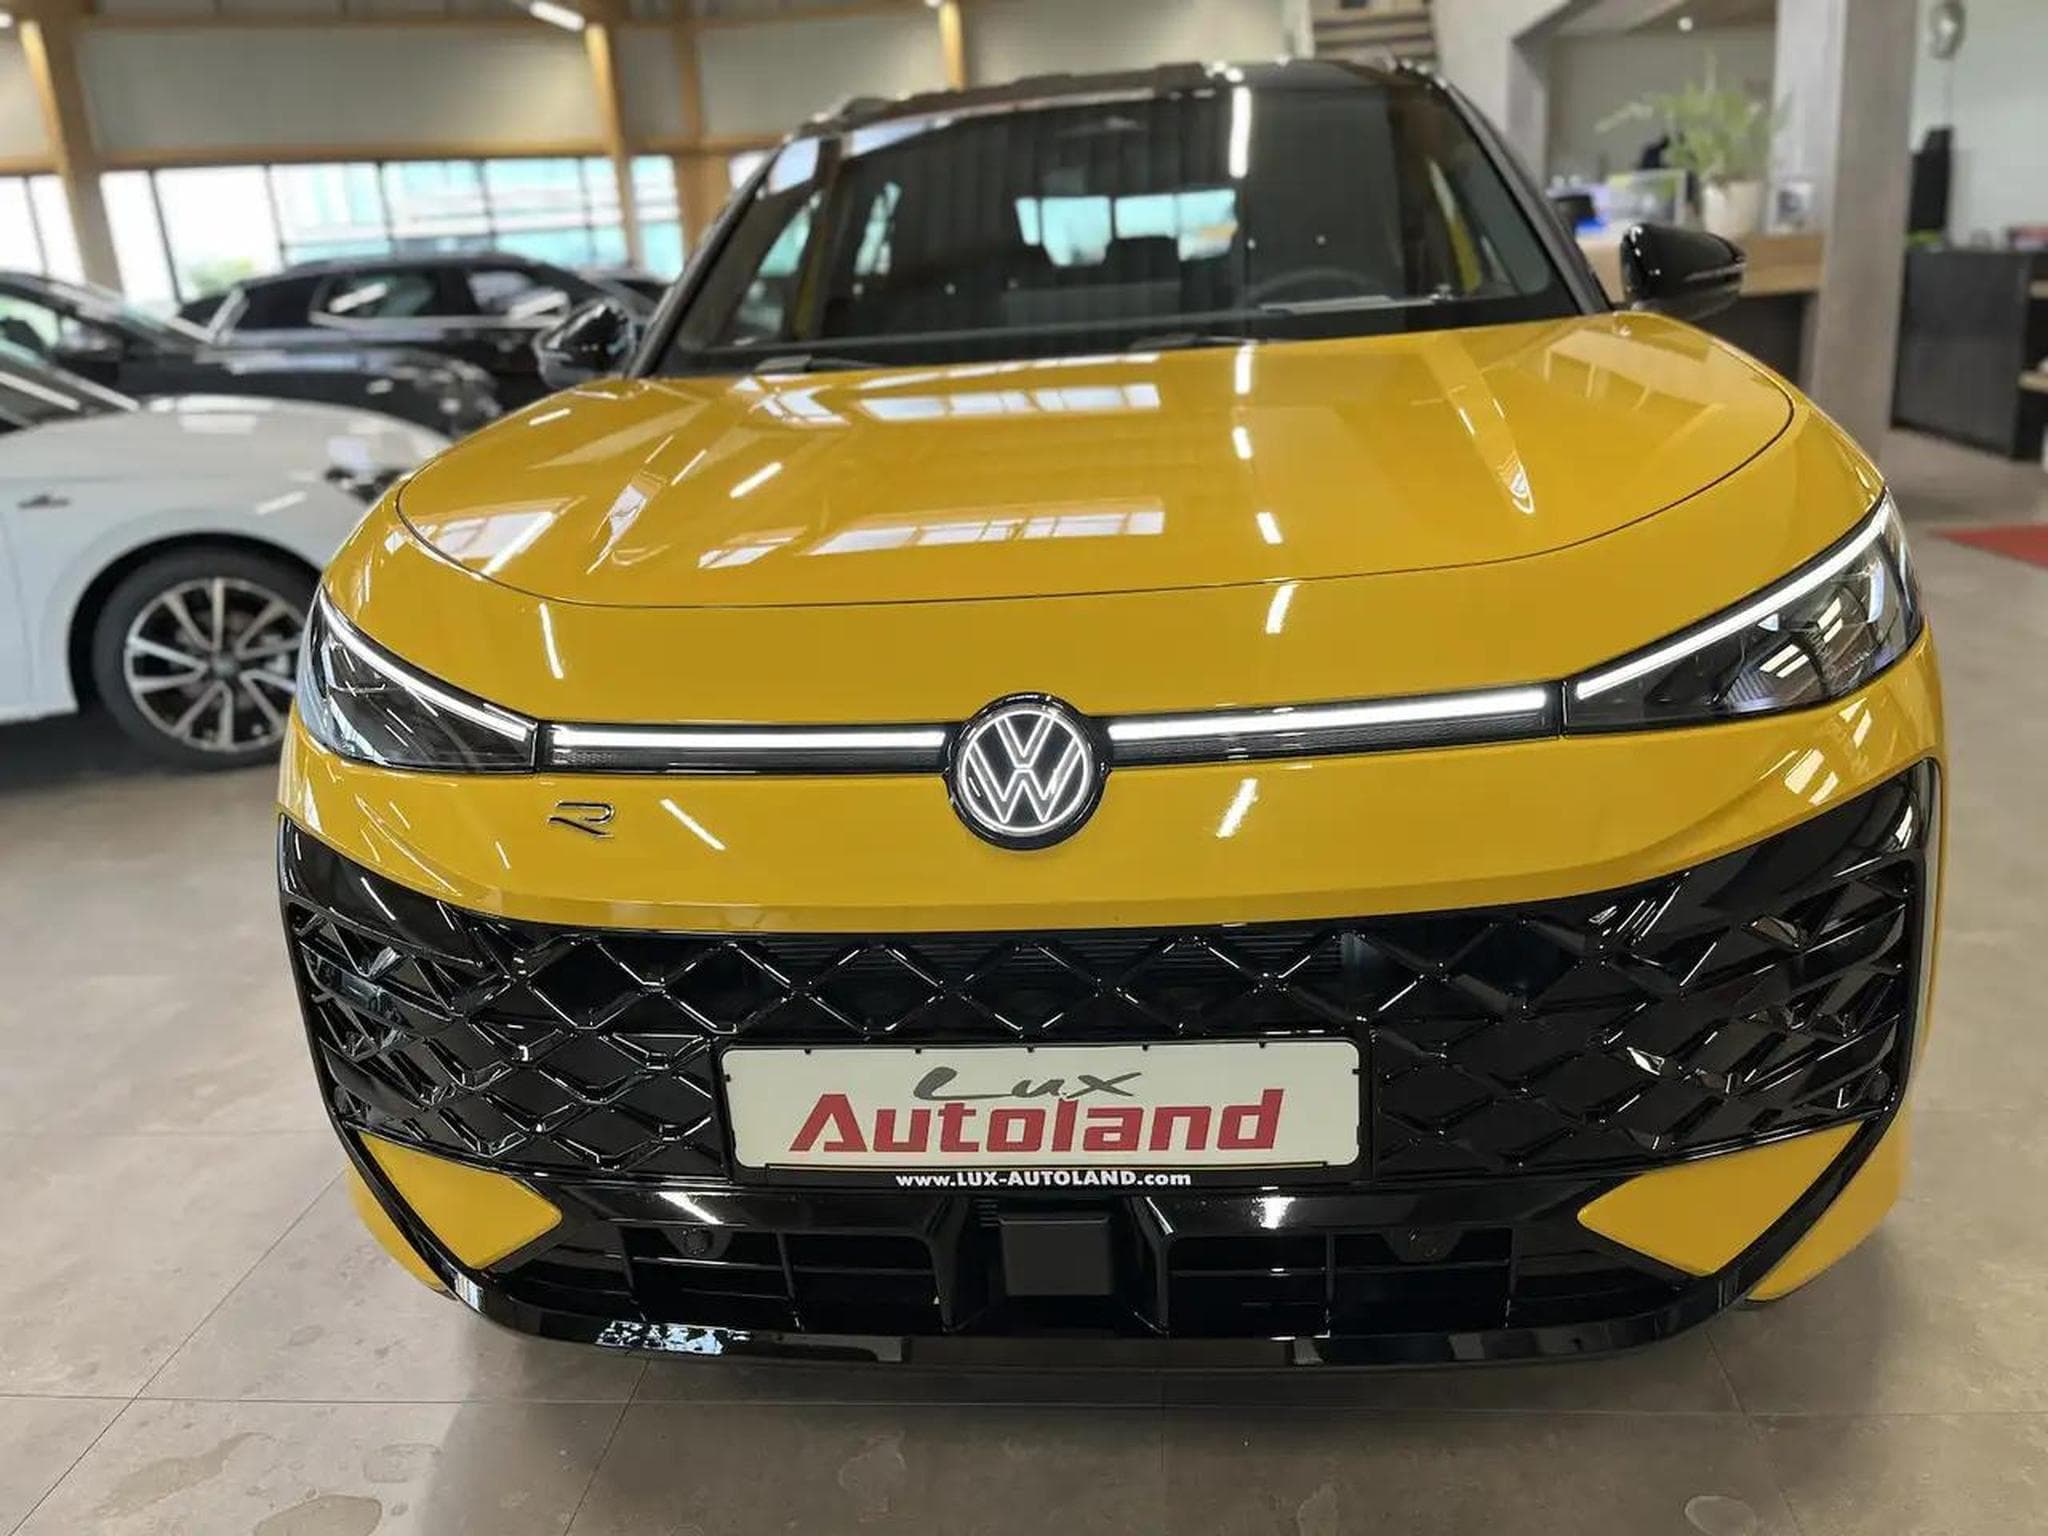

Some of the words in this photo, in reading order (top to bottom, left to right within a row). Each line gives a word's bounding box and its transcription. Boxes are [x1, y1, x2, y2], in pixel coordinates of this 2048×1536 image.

[964, 714, 1085, 825] VW
[912, 1066, 1142, 1100] Lux
[789, 1088, 1284, 1153] Autoland
[896, 1170, 1192, 1187] www.LUX-AUTOLAND.com
